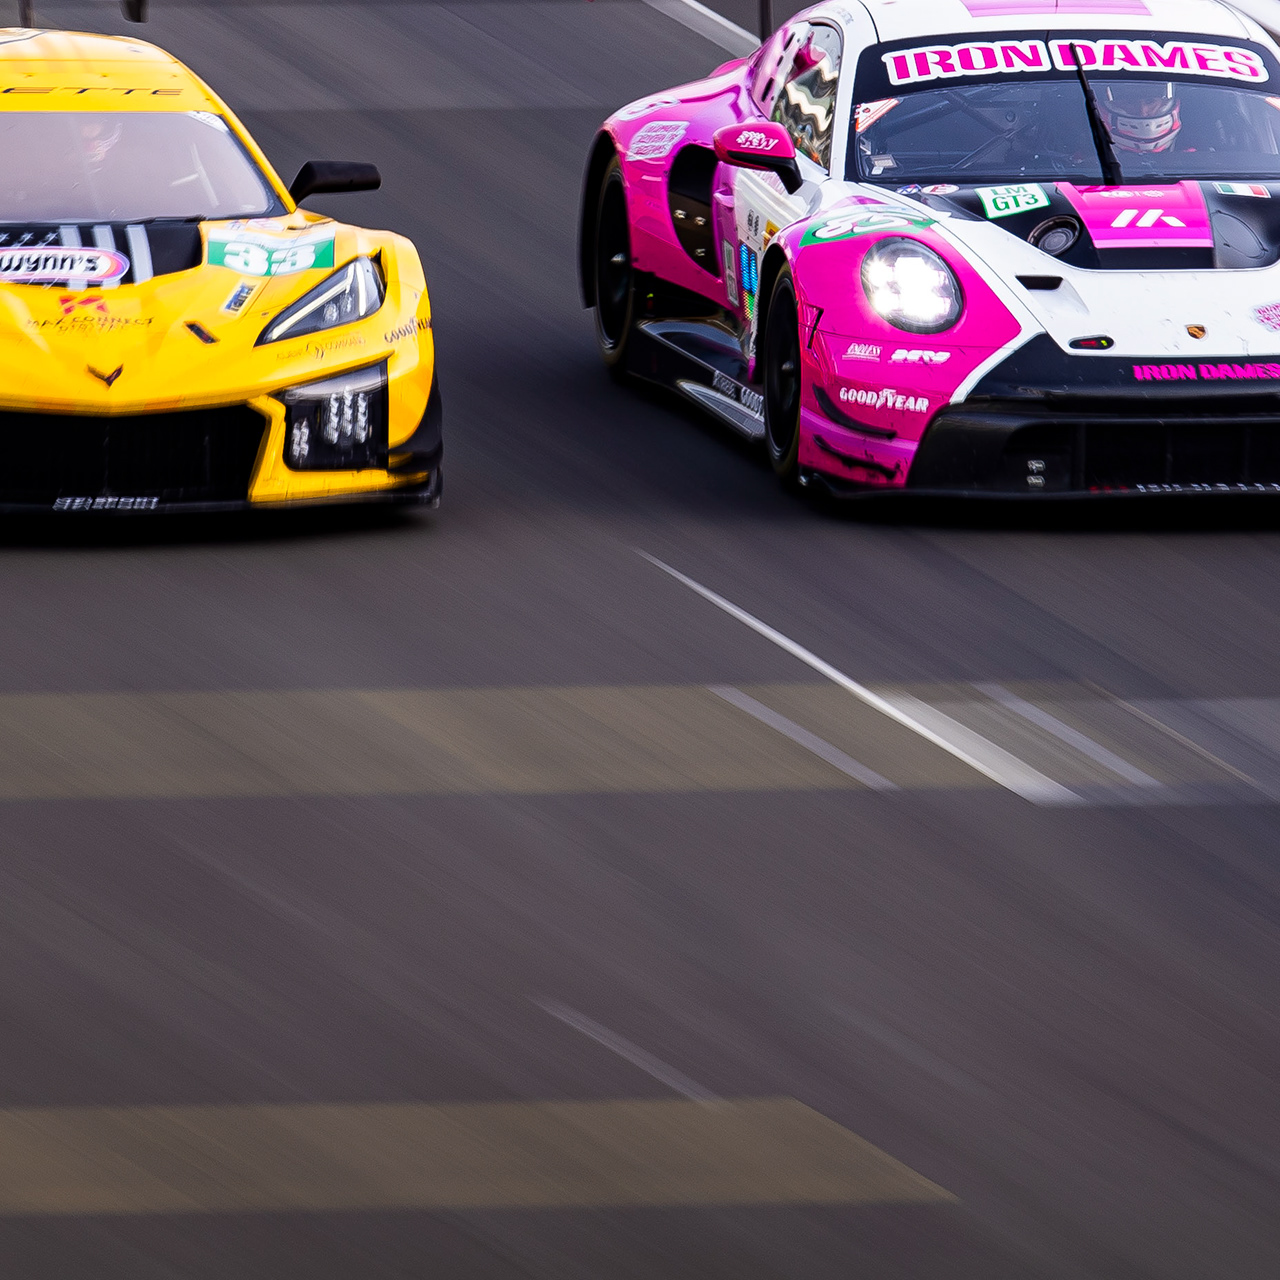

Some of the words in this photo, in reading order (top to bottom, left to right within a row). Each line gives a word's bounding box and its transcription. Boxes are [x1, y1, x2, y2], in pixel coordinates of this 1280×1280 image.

[889, 43, 1044, 81] IRON
[1055, 42, 1261, 78] DAMES
[990, 186, 1028, 195] LM
[991, 194, 1039, 211] GT3
[223, 241, 316, 277] 33
[1132, 364, 1198, 381] IRON
[839, 387, 930, 414] GOODYEAR
